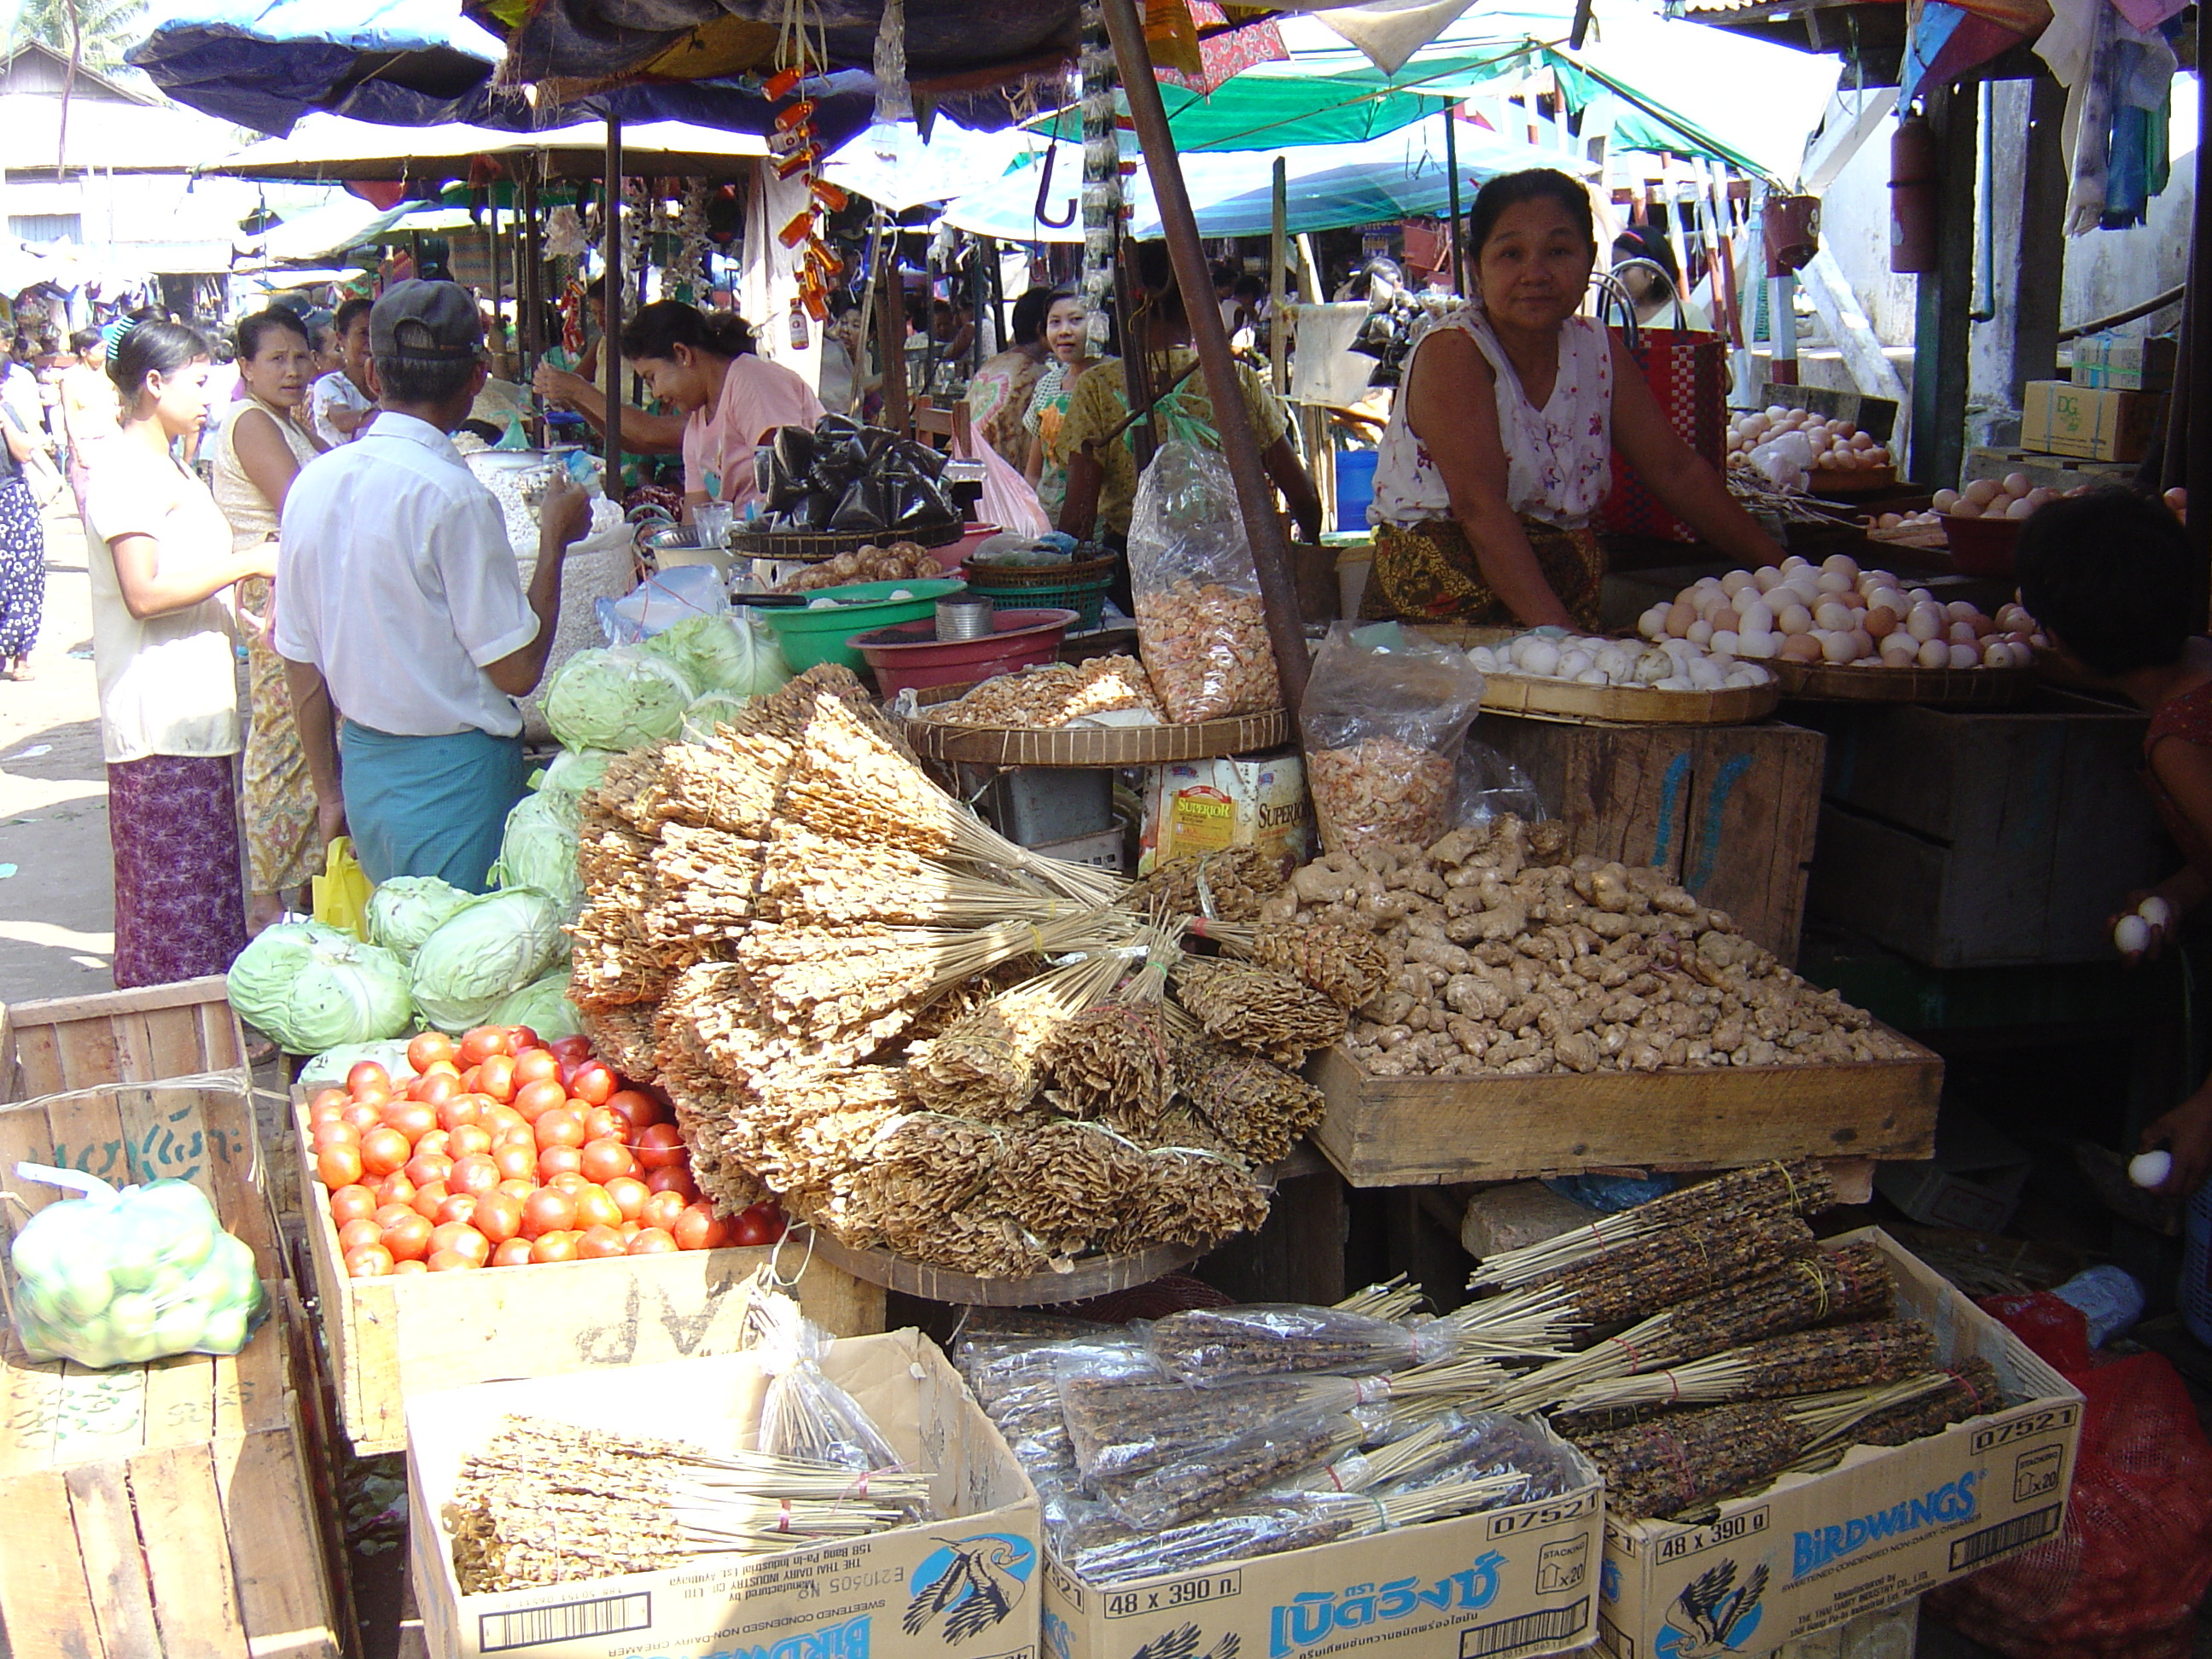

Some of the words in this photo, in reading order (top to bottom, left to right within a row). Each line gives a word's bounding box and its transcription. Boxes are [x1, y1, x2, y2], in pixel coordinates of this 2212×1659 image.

[1178, 798, 1231, 818] SUPERIOR
[1258, 800, 1306, 829] SUPERIO
[1976, 1409, 2071, 1449] 07521
[2019, 1451, 2058, 1470] STACKING
[2032, 1470, 2058, 1492] x20
[1493, 1493, 1596, 1534] 07521
[1662, 1537, 1685, 1558] 48
[1710, 1516, 1745, 1543] 390
[1753, 1514, 1764, 1529] g
[824, 1546, 848, 1560] Bang
[852, 1542, 871, 1556] 158
[1543, 1541, 1586, 1559] STACKING
[742, 1557, 789, 1573] Industrial
[794, 1552, 820, 1566] Pa-In
[817, 1561, 839, 1574] THAI
[847, 1557, 862, 1569] THE
[783, 1567, 812, 1580] DAIRY
[1558, 1563, 1584, 1586] x20
[1781, 1568, 1836, 1593] SWEETENED
[1836, 1547, 1889, 1572] CONDENSED
[731, 1573, 780, 1590] INDUSTRY
[745, 1579, 815, 1600] Manufactured
[1344, 1582, 1375, 1598] ตรา
[729, 1592, 741, 1602] by
[1109, 1593, 1138, 1615] 48
[1168, 1579, 1210, 1604] 390
[817, 1599, 886, 1620] SWEETENED
[742, 1613, 814, 1633] CONDENSED
[674, 1627, 740, 1648] NON-DAIRY
[608, 1640, 670, 1658] CREAMER
